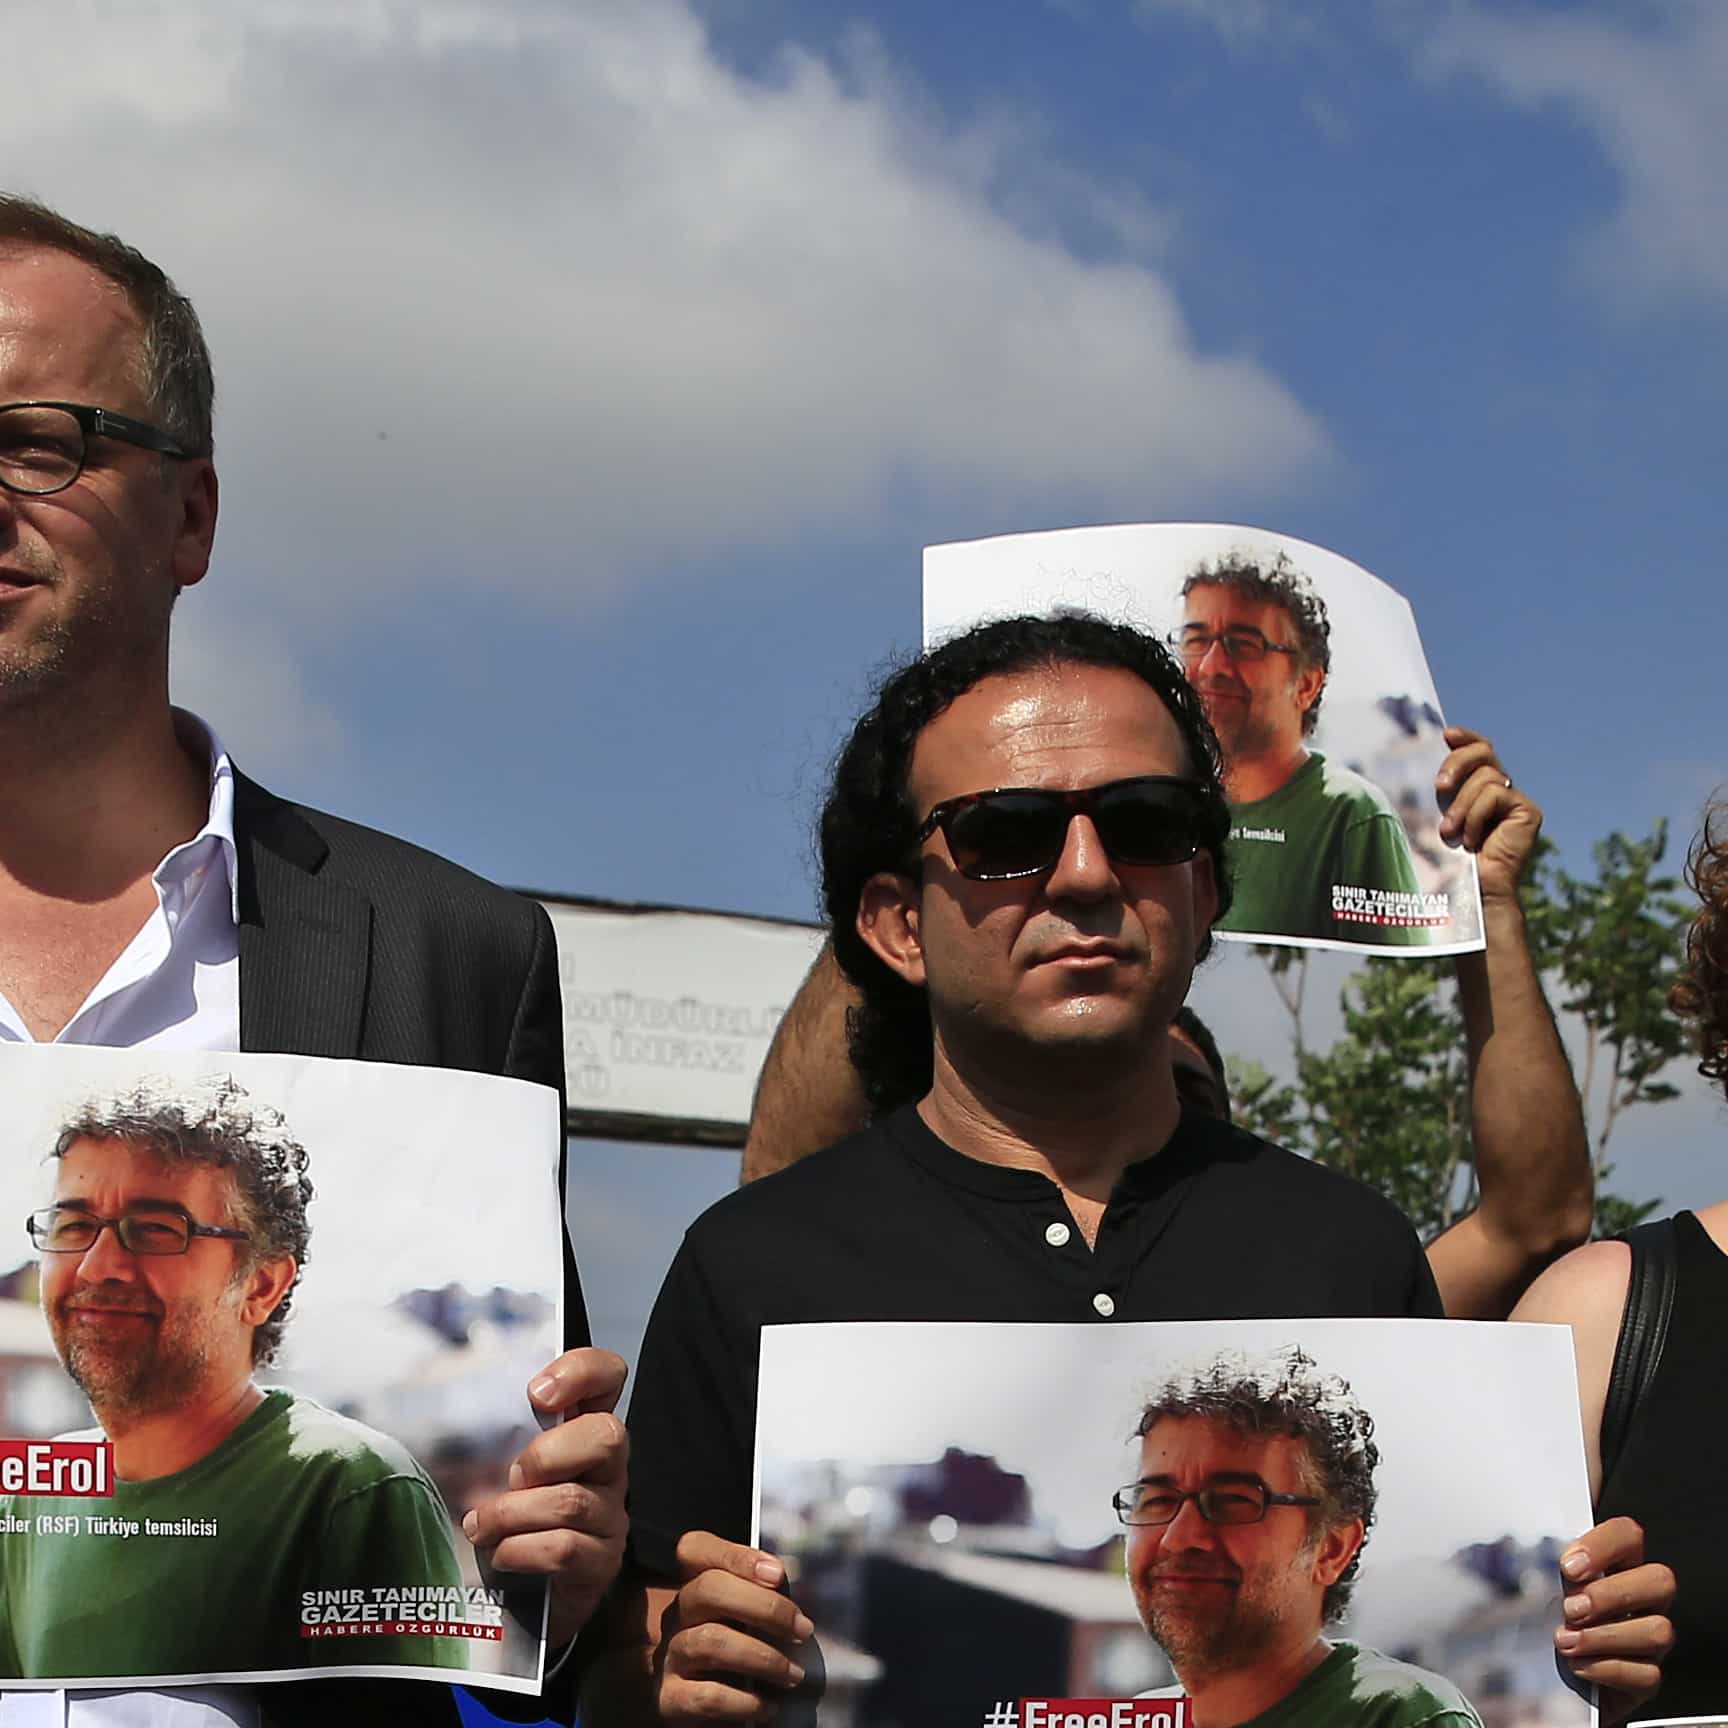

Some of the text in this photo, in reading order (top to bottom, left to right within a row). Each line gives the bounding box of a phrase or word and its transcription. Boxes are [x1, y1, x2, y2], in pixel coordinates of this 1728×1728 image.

[1332, 885, 1449, 905] SINIR TANIMAYAN
[37, 1515, 80, 1538] (RSF)
[85, 1516, 140, 1538] Türkiye
[144, 1517, 218, 1537] temsilcisi
[301, 1586, 504, 1606] SINIR TANIMAYAN
[310, 1624, 384, 1636] HABERE
